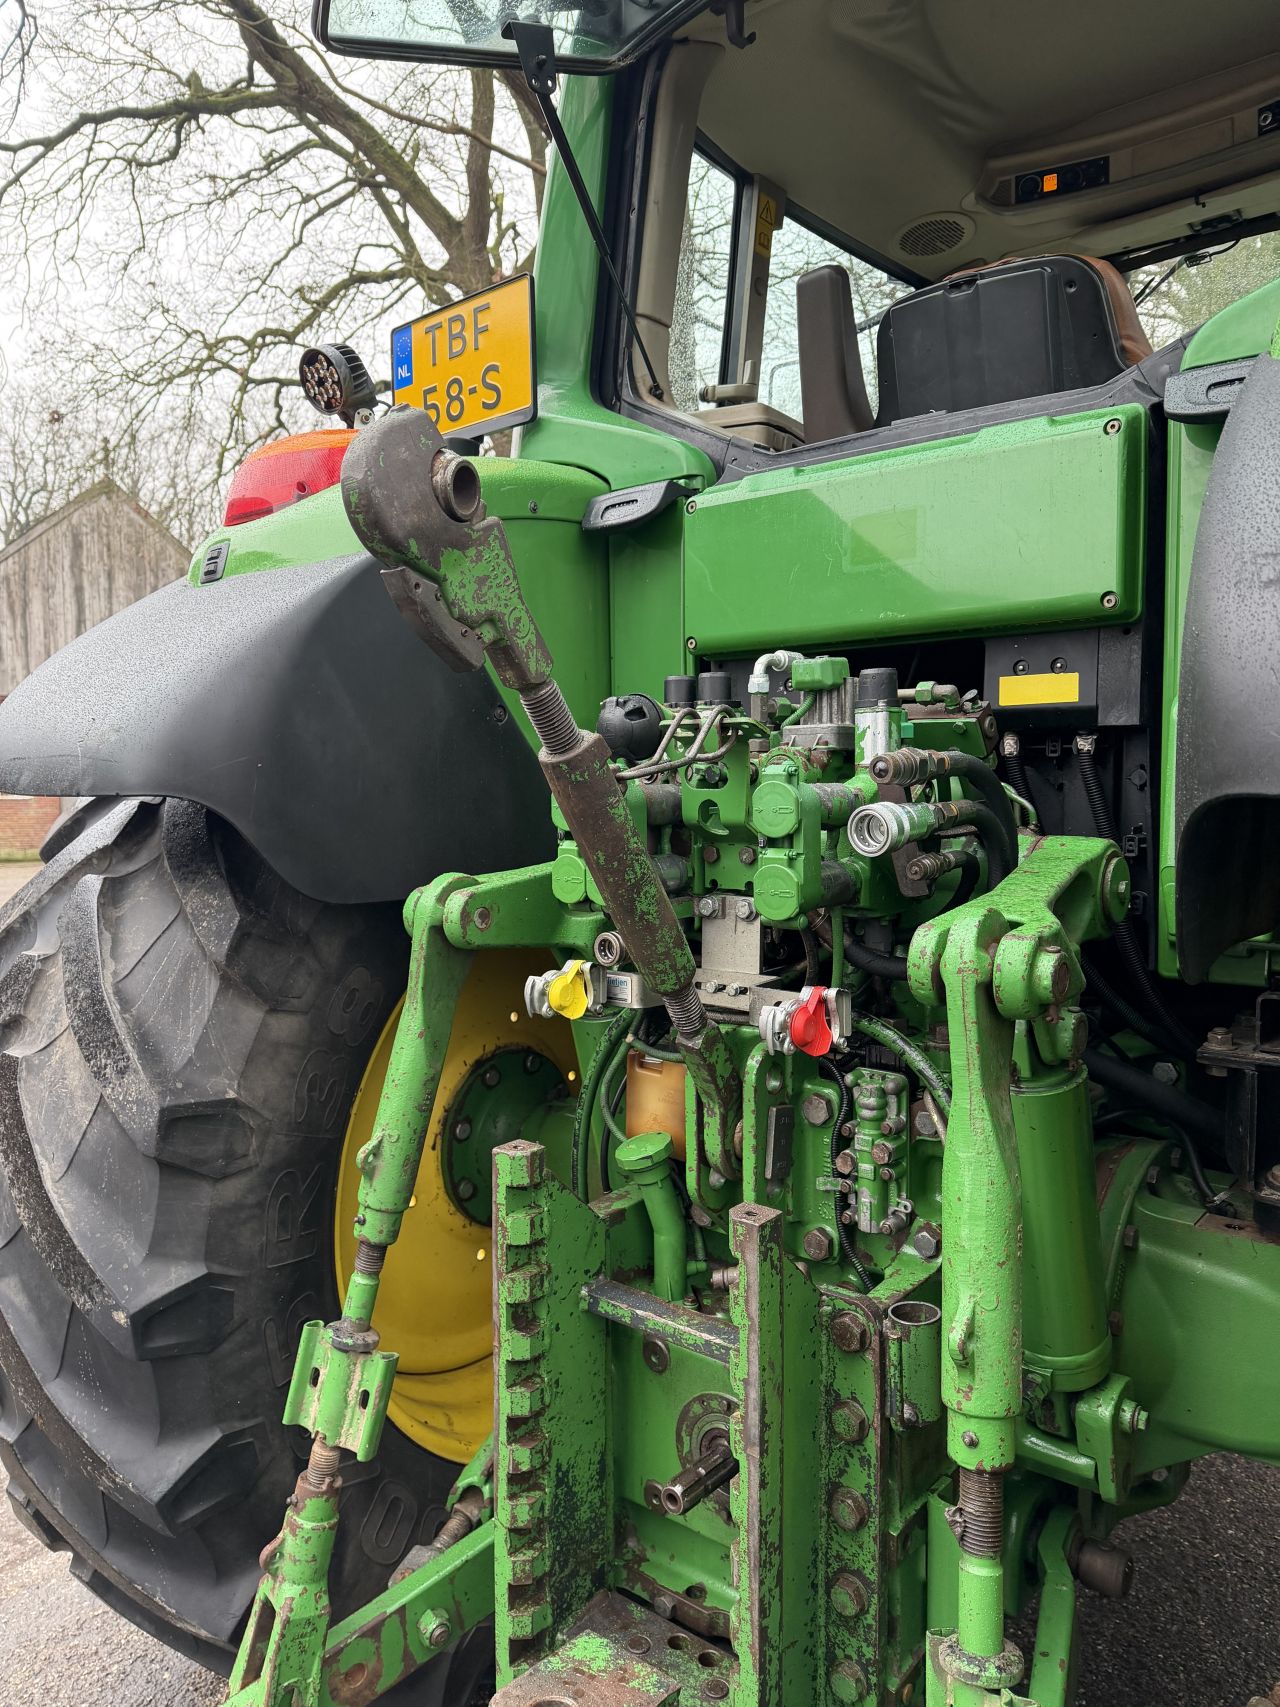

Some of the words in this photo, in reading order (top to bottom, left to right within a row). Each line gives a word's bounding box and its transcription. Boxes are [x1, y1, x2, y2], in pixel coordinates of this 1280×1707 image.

[424, 302, 491, 367] TBF
[397, 363, 411, 380] NL
[422, 363, 502, 426] 58-S
